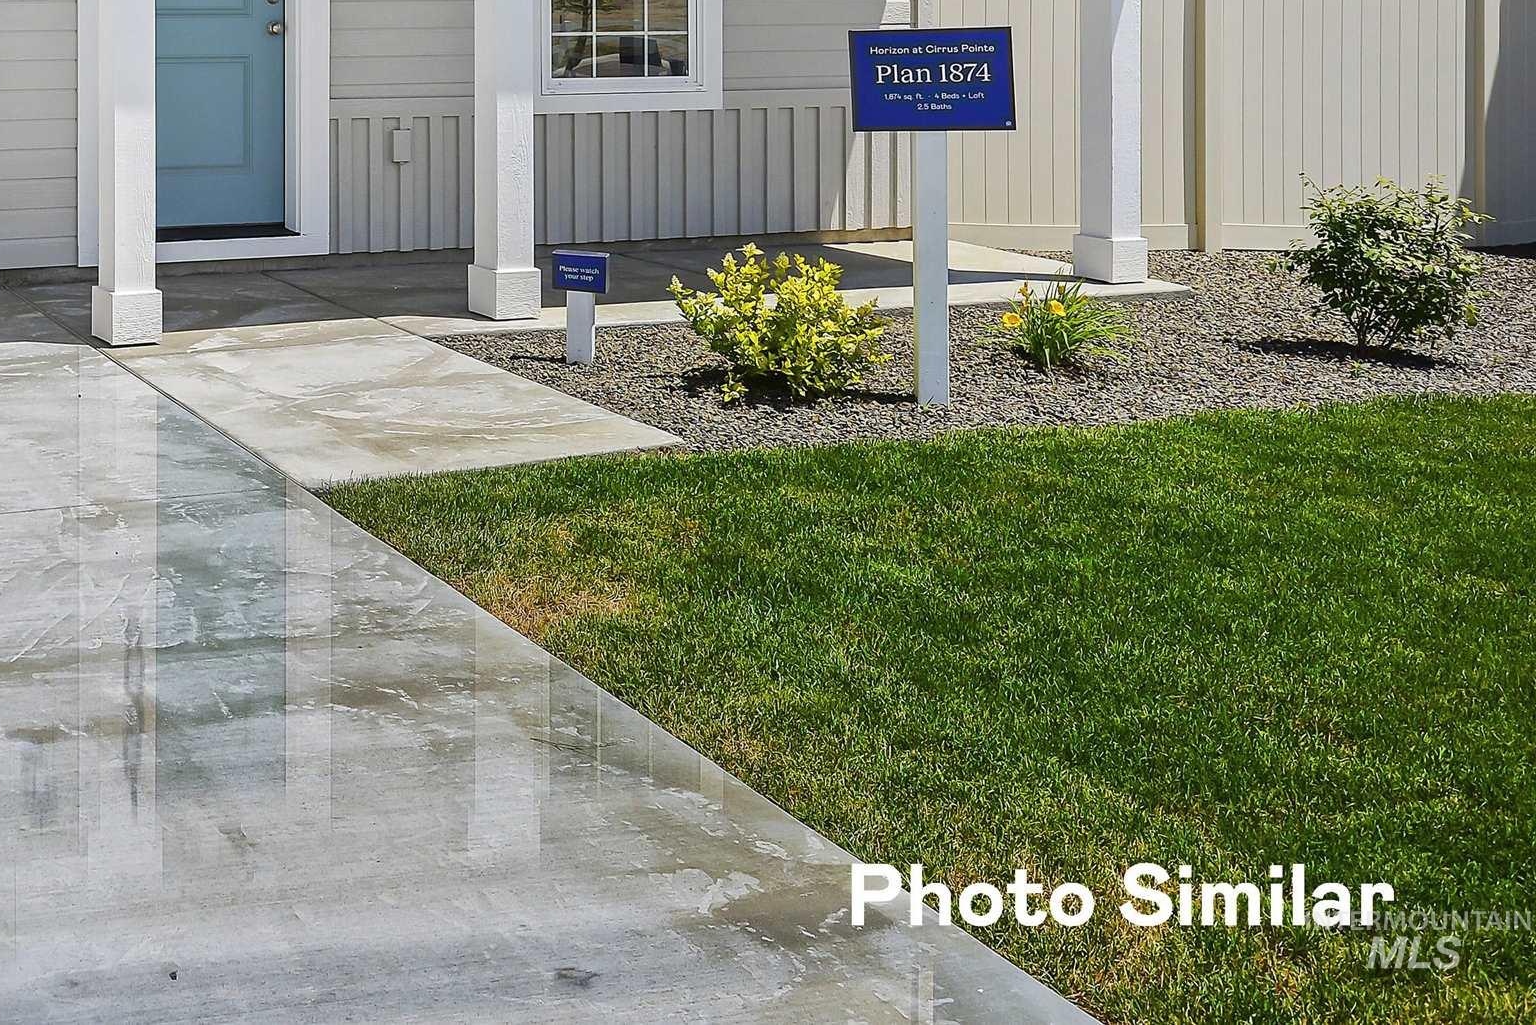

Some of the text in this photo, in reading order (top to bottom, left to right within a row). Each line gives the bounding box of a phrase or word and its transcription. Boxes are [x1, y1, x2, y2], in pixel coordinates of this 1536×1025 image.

[869, 44, 995, 55] Horizon at Cirrus Pointe
[875, 63, 991, 84] Plan 1874
[941, 92, 960, 100] Beds
[968, 91, 985, 99] Loft
[559, 265, 579, 273] Please
